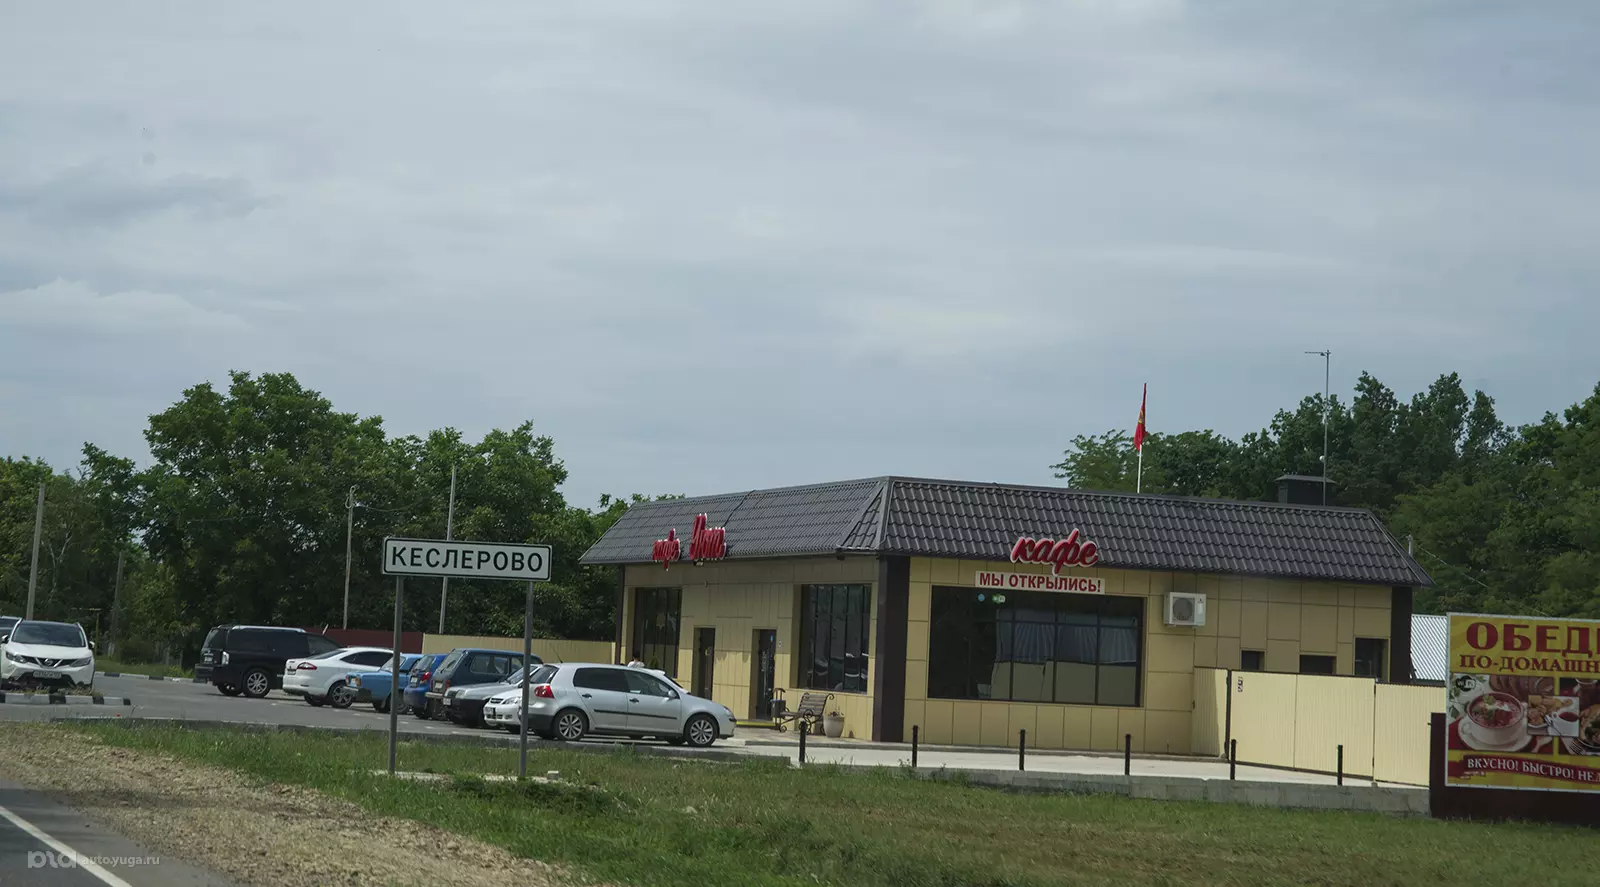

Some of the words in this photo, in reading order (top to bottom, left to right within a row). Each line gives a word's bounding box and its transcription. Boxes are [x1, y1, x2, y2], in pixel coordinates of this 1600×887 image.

[392, 546, 543, 573] КЕСЛЕРОВО
[1010, 527, 1099, 576] кафе
[980, 572, 1004, 587] МЫ
[1008, 574, 1101, 593] ОТКРЫЛИСЬ!
[1466, 622, 1600, 658] ОБЕД
[1467, 758, 1519, 772] ВКУСНО!
[1522, 761, 1574, 779] БЫСТРО!
